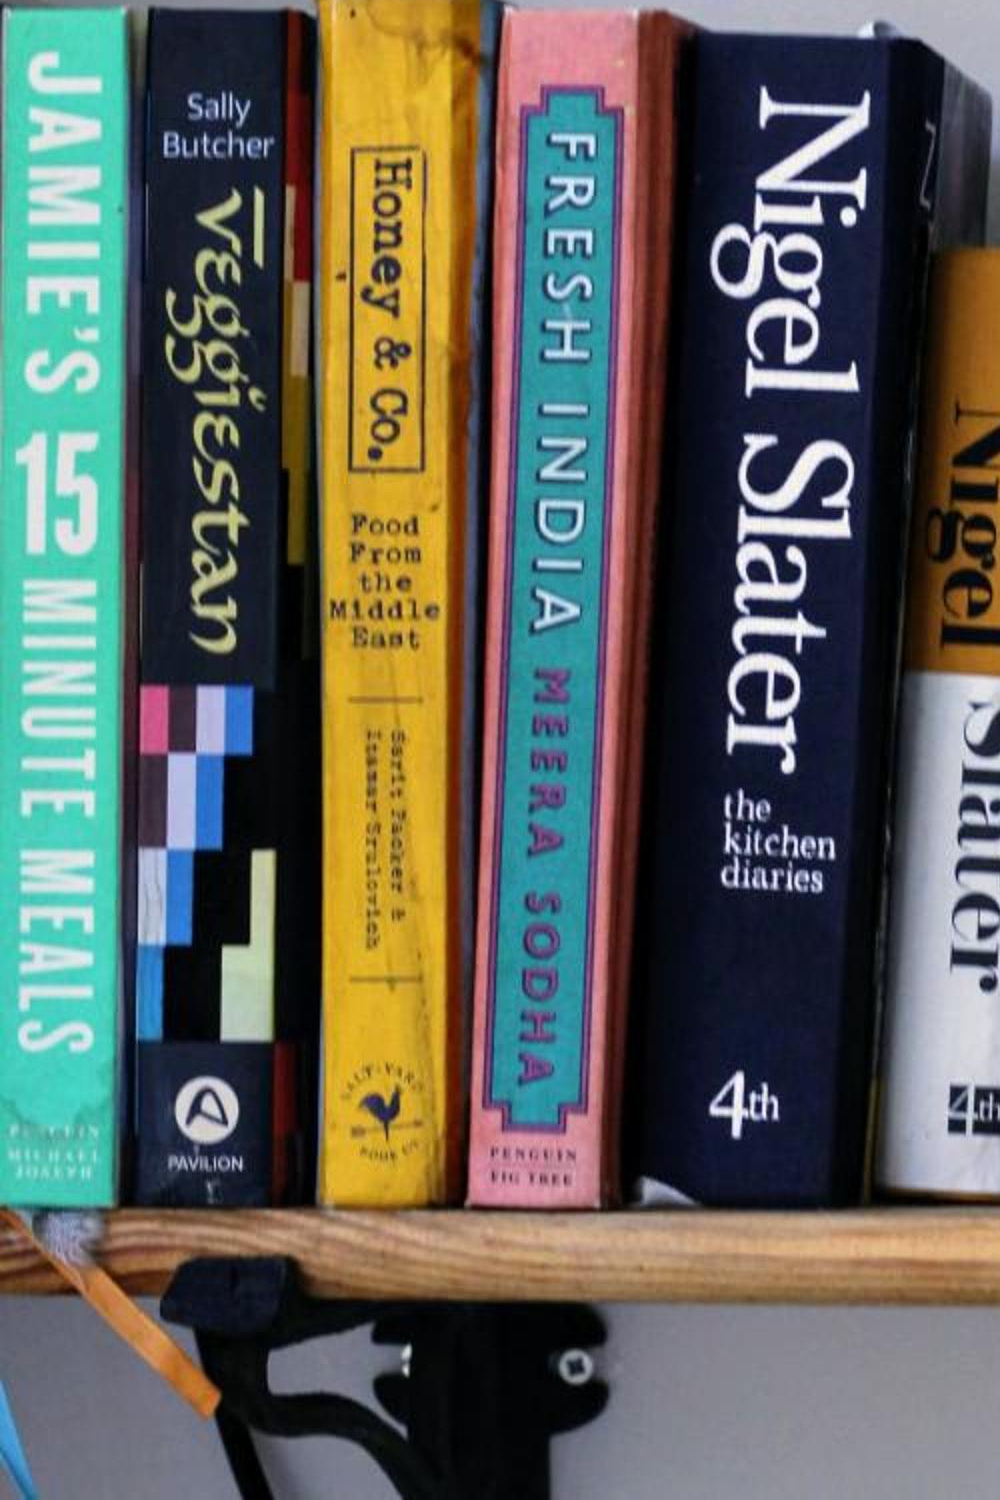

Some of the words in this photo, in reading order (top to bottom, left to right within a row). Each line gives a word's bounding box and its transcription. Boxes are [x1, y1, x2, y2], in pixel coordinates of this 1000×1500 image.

[187, 92, 252, 122] Sally
[163, 132, 275, 160] Butcher
[24, 51, 103, 394] JAMIE'S
[360, 158, 412, 319] Honey
[543, 131, 598, 364] FRESH
[709, 85, 871, 399] Nigel
[373, 336, 412, 370] &
[367, 387, 408, 462] Co.
[15, 431, 99, 557] 15
[529, 402, 590, 635] INDIA
[351, 514, 419, 536] Food
[350, 541, 421, 564] From
[330, 598, 440, 620] Middle
[360, 573, 411, 593] the
[725, 432, 855, 776] Slater
[351, 626, 420, 651] East
[20, 579, 98, 817] MINUTE
[526, 667, 571, 858] MEERA
[724, 789, 772, 822] the
[724, 824, 836, 860] kitchen
[721, 857, 825, 894] diaries
[17, 850, 96, 1054] MEALS
[518, 893, 562, 1087] SODHA
[709, 1070, 779, 1140] 4th
[167, 1155, 244, 1172] PAVILION
[490, 1147, 577, 1162] PENGUIN
